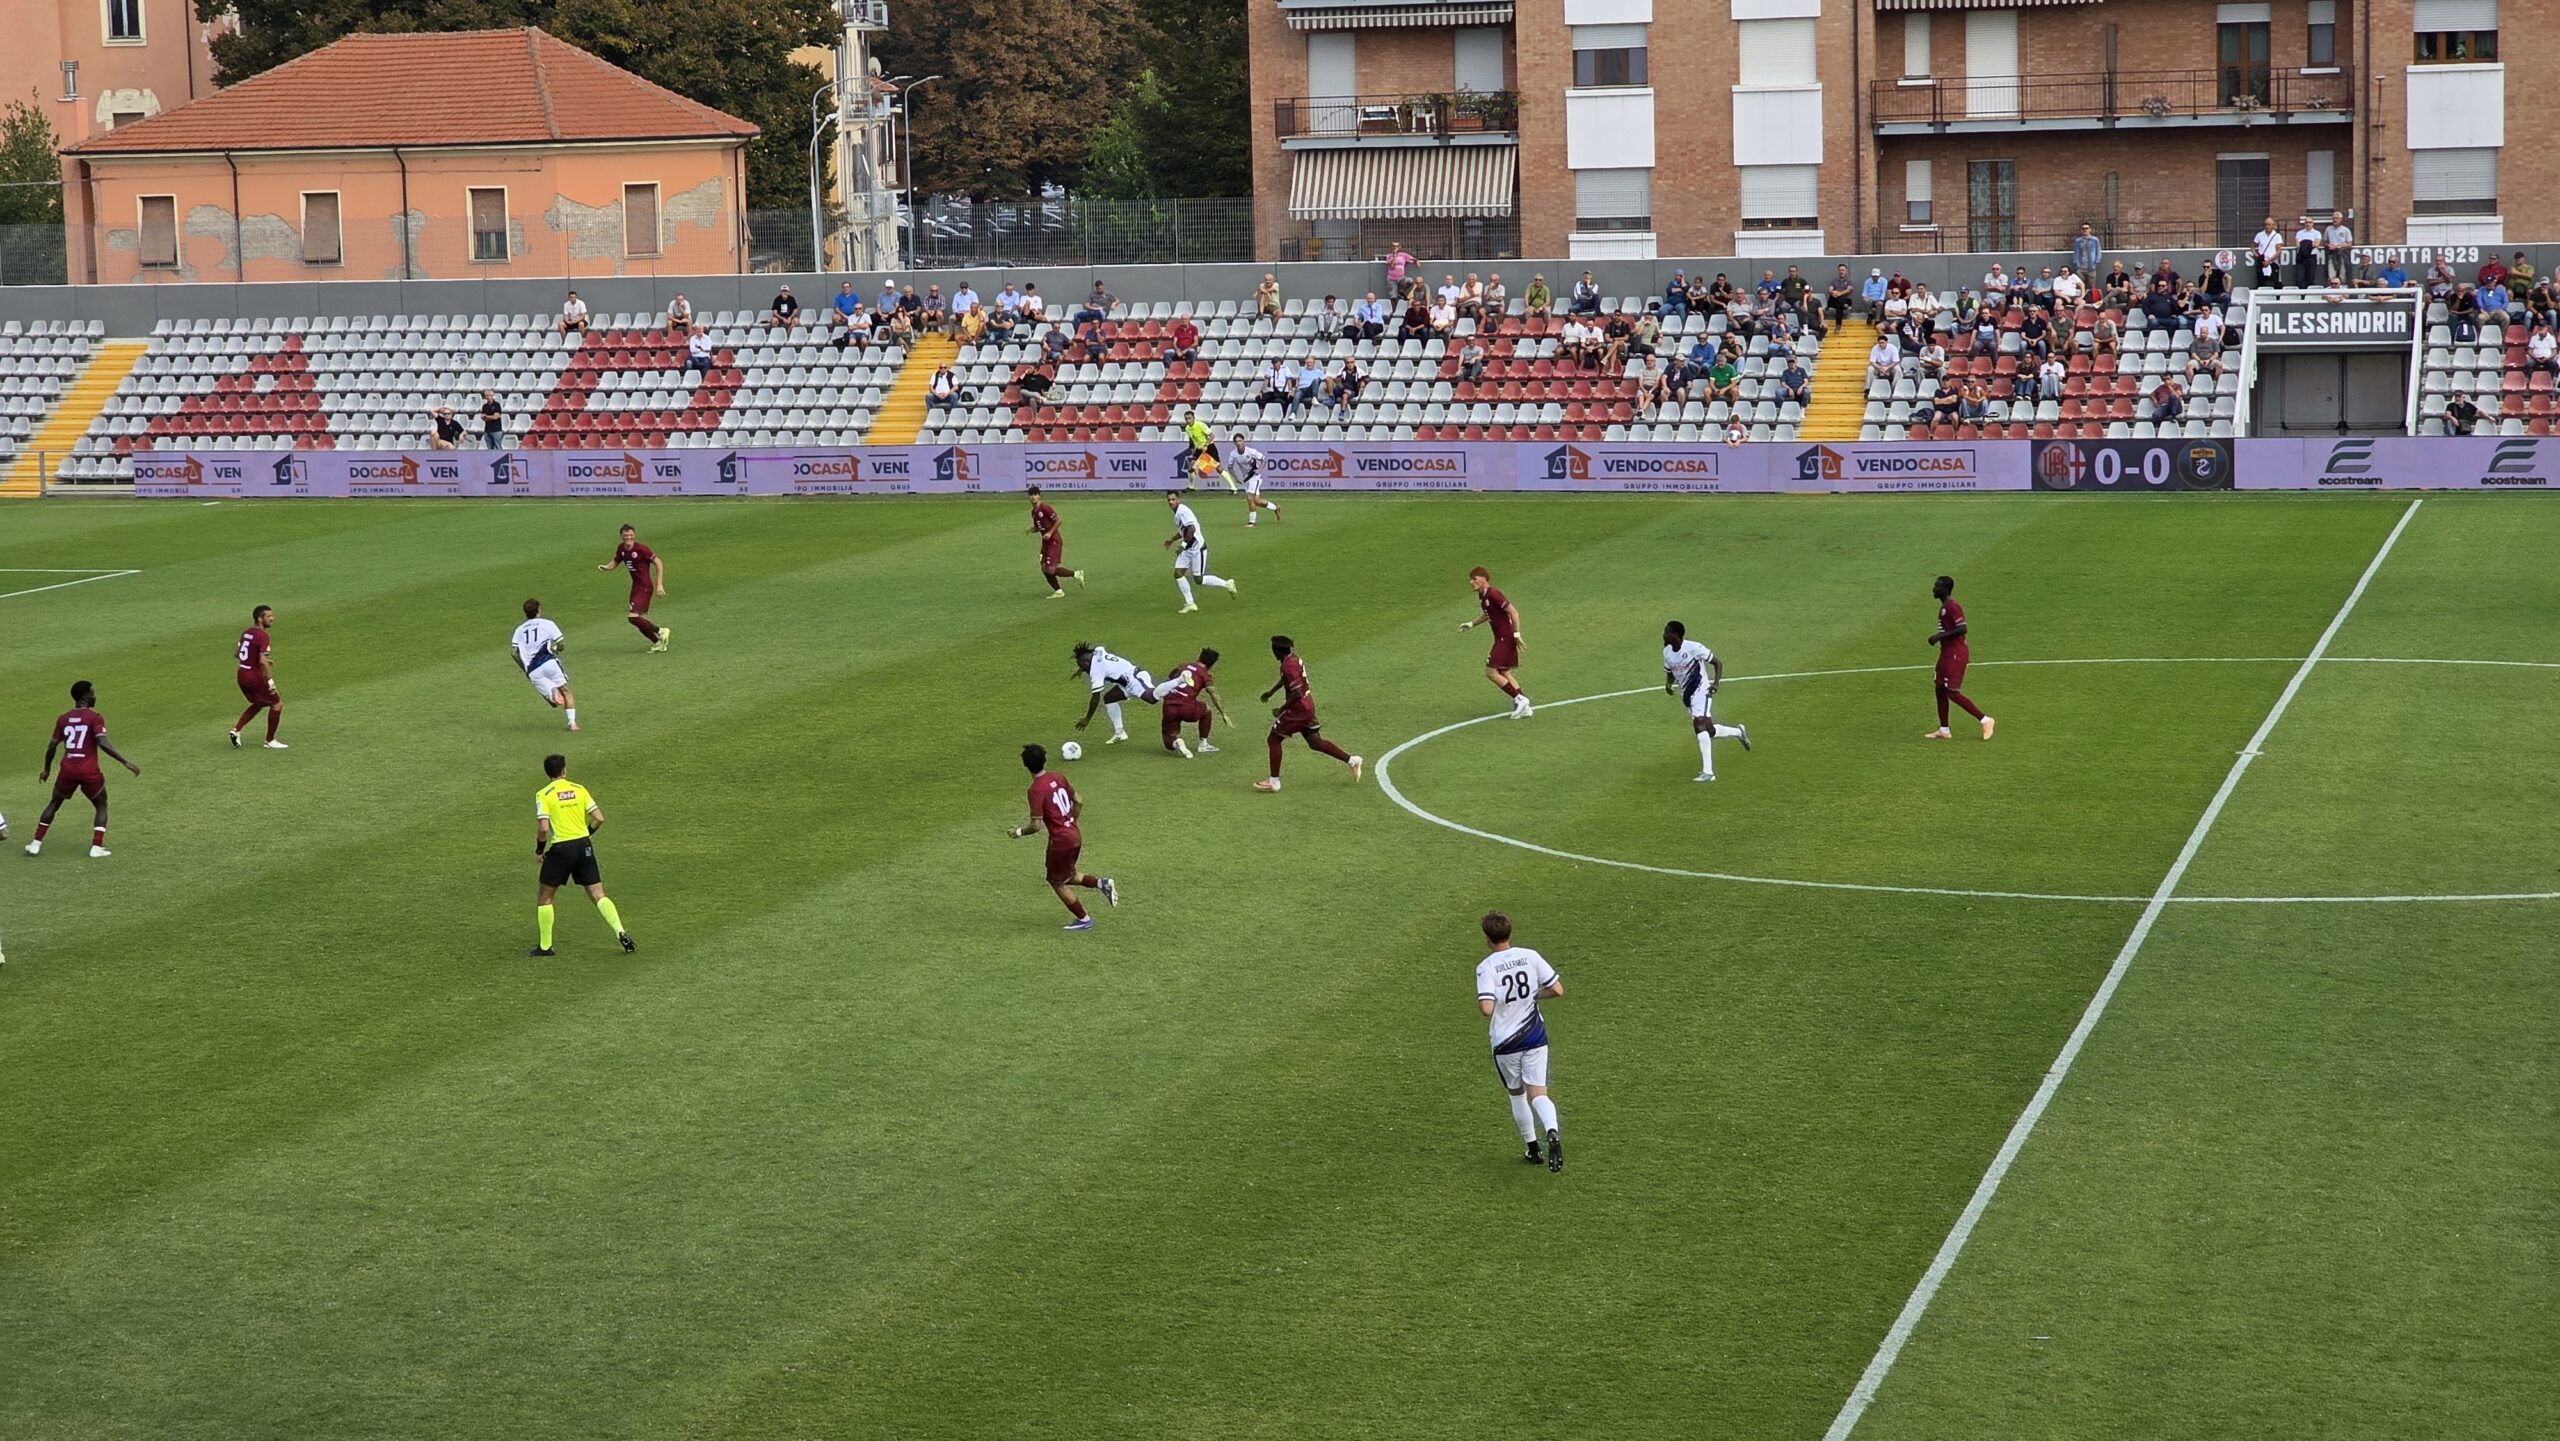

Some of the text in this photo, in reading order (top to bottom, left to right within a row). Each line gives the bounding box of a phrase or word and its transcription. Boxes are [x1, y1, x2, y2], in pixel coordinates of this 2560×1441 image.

[2260, 310, 2407, 334] ALESSANDRIA
[1356, 458, 1457, 471] VENDOCASA
[1603, 459, 1709, 473] VENDOCASA
[1856, 457, 1966, 472] VENDOCASA
[2094, 447, 2171, 485] 0-0
[1917, 481, 1977, 489] IMMOBILIARE
[2317, 476, 2383, 486] ecostream
[2480, 476, 2547, 486] ecostream
[523, 627, 538, 645] 11
[63, 724, 89, 749] 27
[1052, 787, 1071, 817] 10
[1501, 970, 1530, 1004] 28
